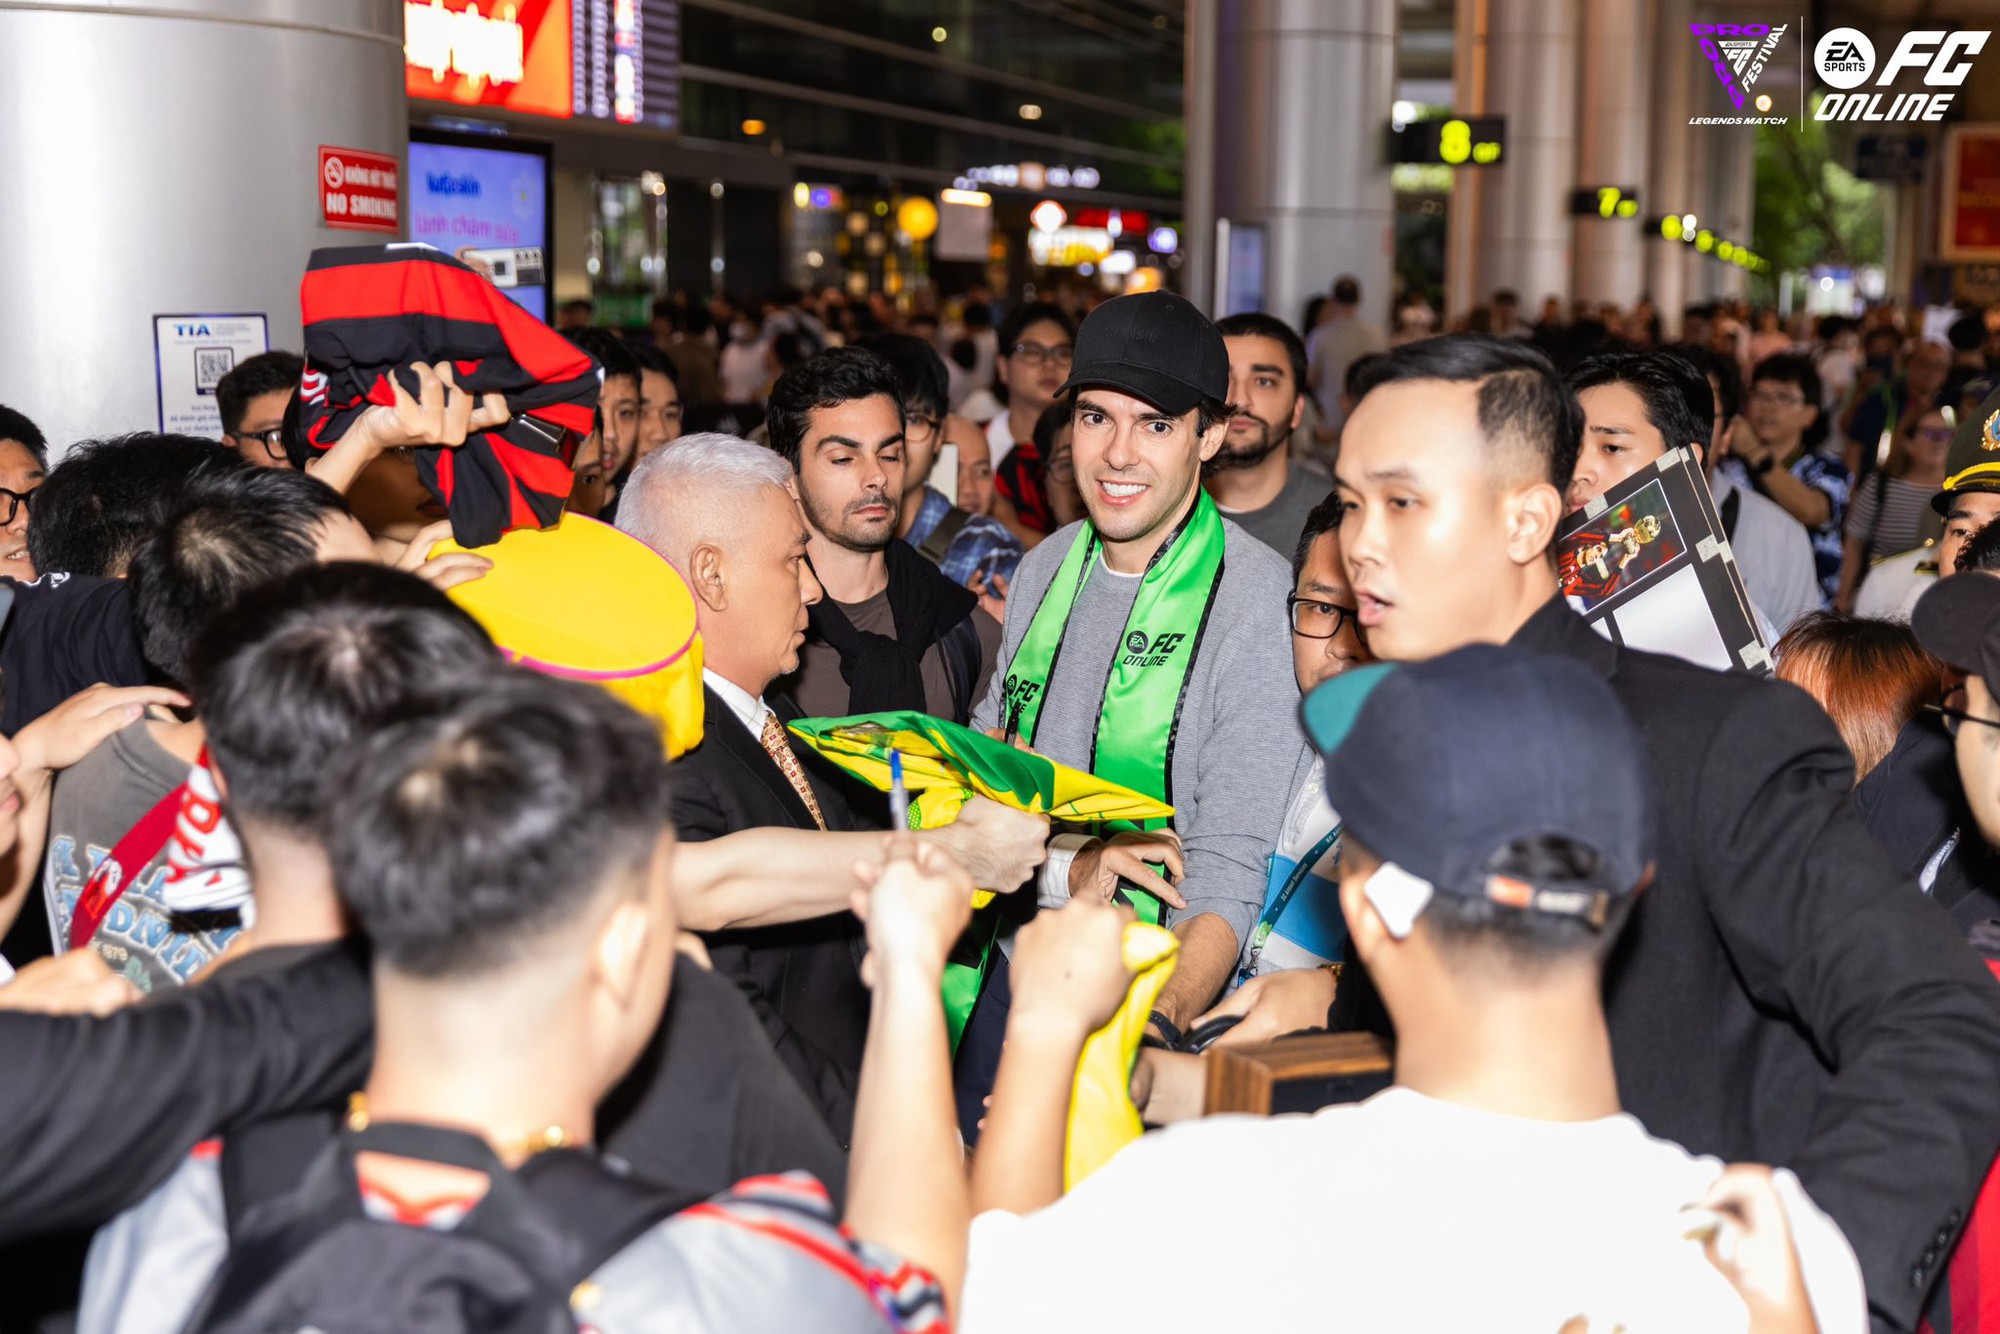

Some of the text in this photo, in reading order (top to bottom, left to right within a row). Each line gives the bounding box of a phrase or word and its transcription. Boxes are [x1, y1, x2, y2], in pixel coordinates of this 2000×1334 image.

[326, 191, 348, 215] NO
[173, 323, 210, 336] TIA
[1147, 633, 1187, 654] FC
[1122, 655, 1169, 667] ONLINE
[1013, 679, 1041, 702] FC
